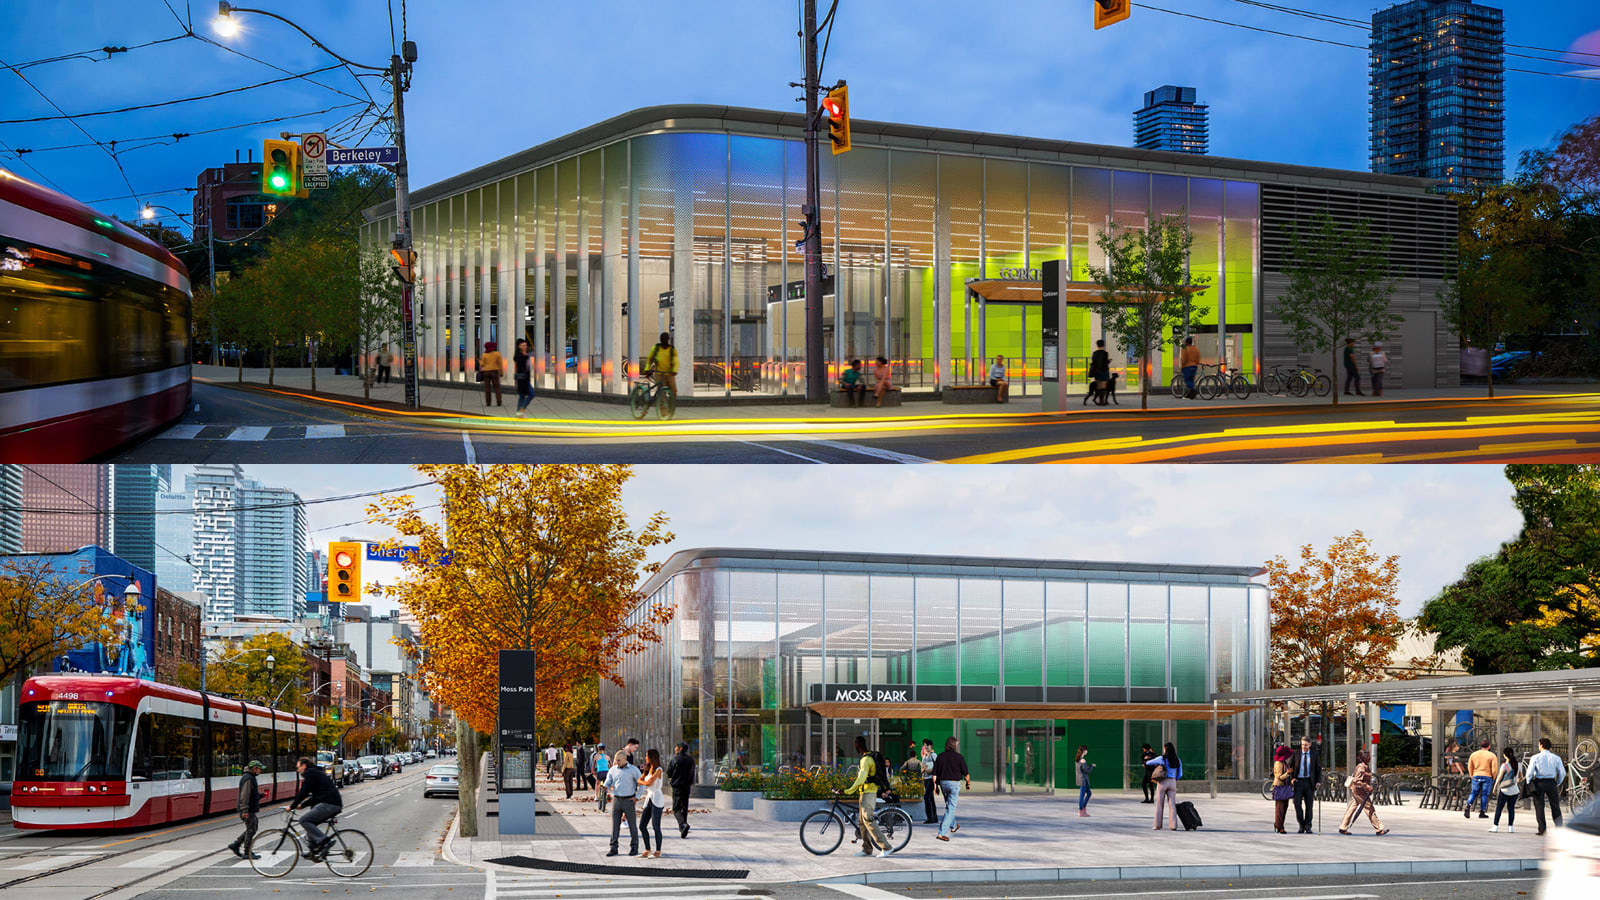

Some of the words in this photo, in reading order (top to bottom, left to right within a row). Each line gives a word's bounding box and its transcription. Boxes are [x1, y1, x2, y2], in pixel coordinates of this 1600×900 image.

[333, 150, 381, 162] Berkeley
[835, 690, 872, 701] MOSS
[877, 690, 907, 701] PARK
